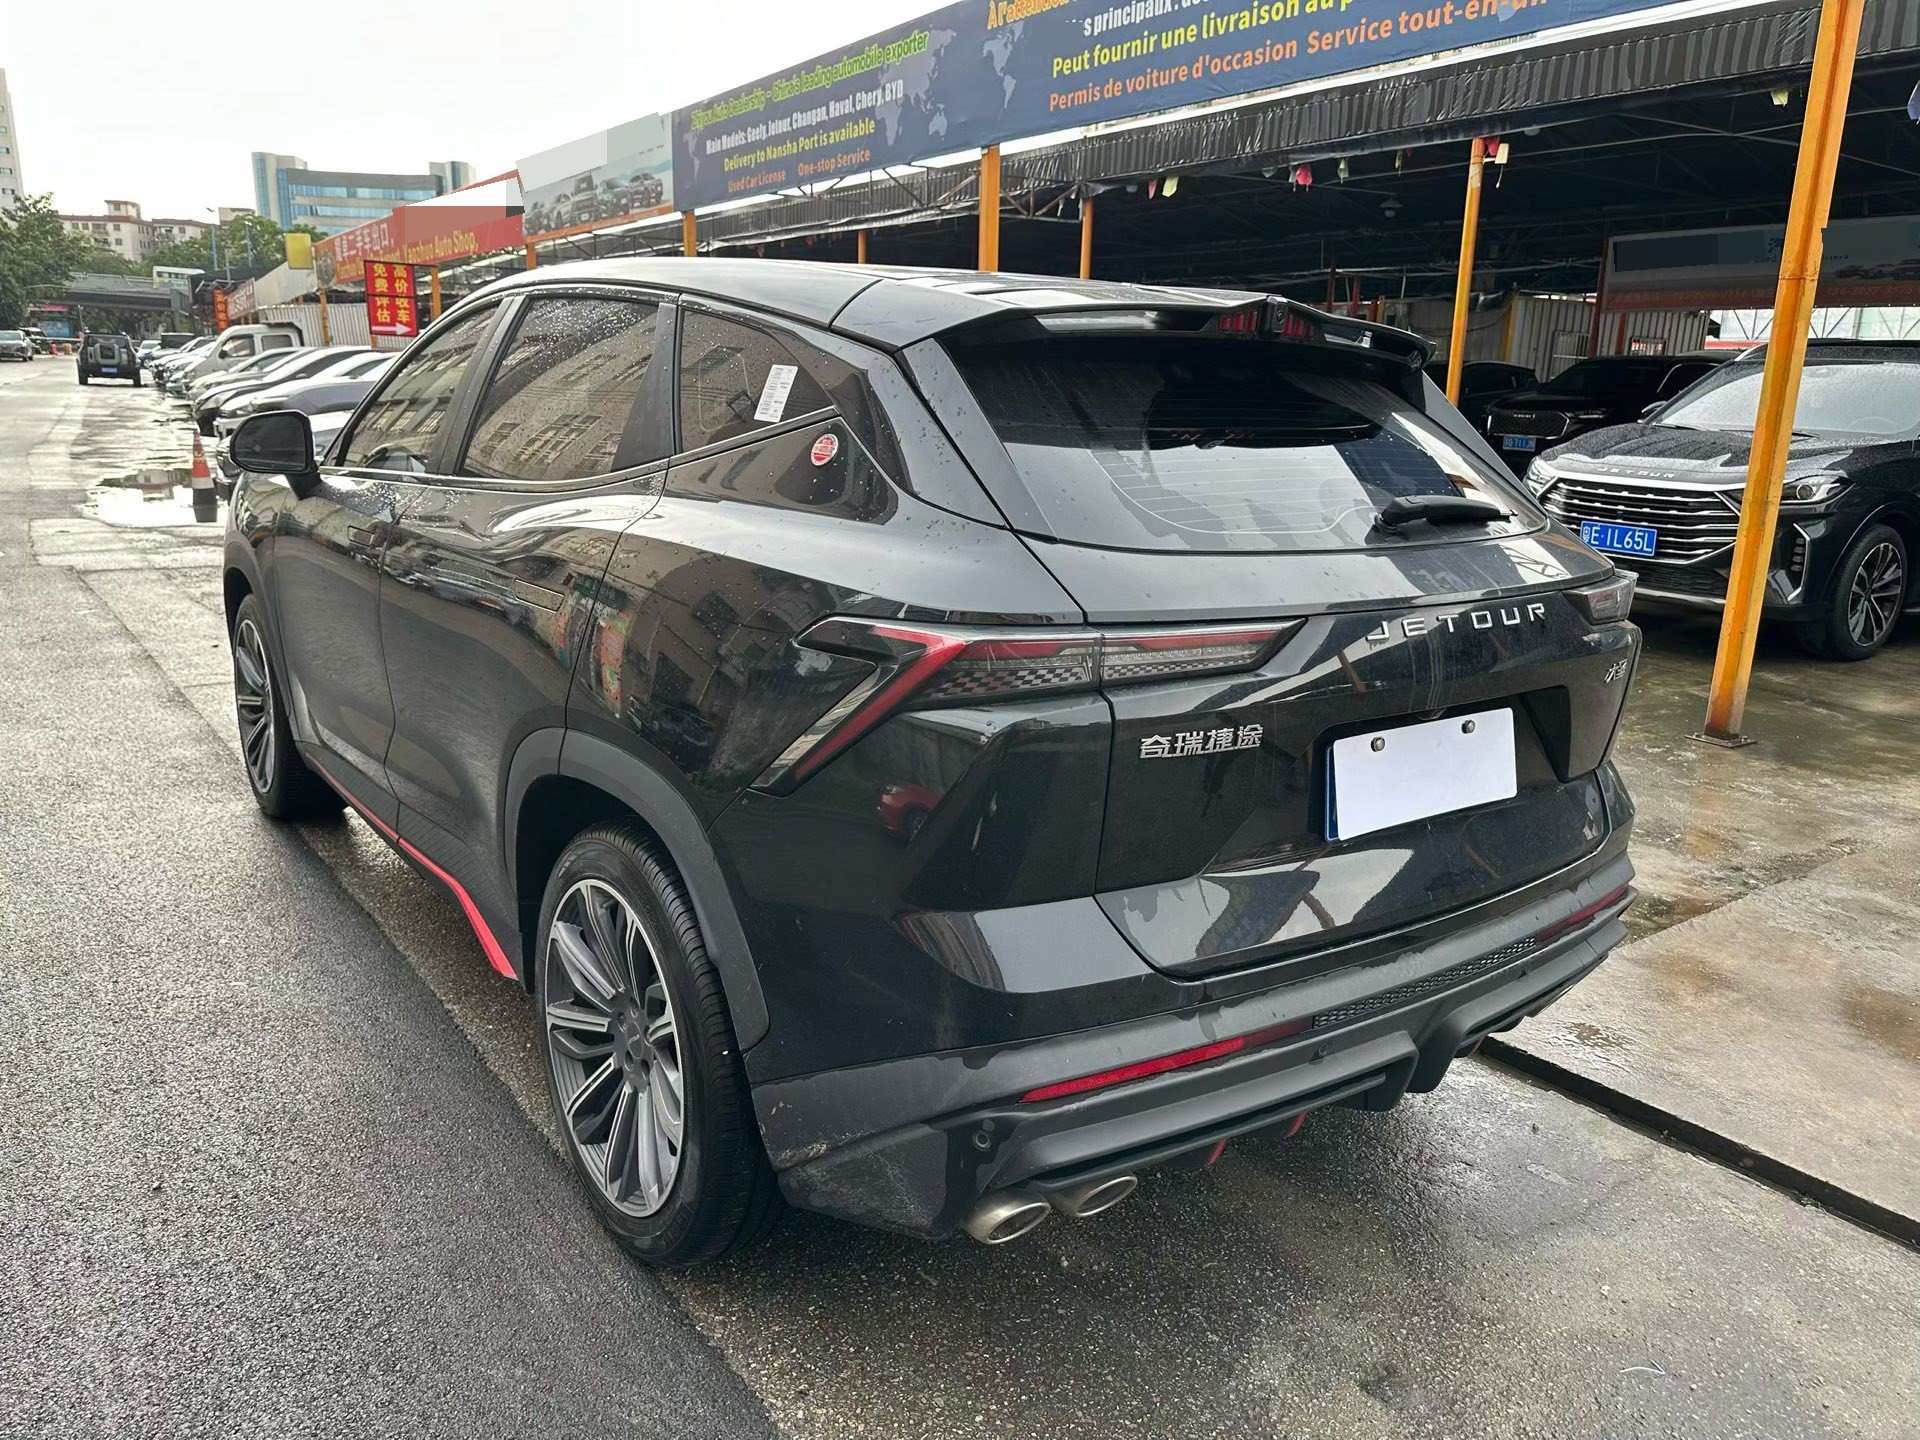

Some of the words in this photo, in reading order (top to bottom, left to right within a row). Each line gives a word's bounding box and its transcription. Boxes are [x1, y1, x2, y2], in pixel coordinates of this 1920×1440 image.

[1052, 54, 1090, 78] Peut
[1093, 30, 1159, 67] fournir
[1161, 24, 1197, 50] une
[1202, 0, 1300, 39] livraison
[772, 75, 801, 101] China's
[800, 65, 832, 91] leading
[832, 44, 883, 79] automobile
[885, 31, 929, 65] exporter
[1049, 83, 1101, 111] Permis
[1103, 78, 1122, 99] de
[1126, 63, 1188, 95] voiture
[1192, 38, 1297, 81] d'occasion
[1306, 17, 1392, 55] Service
[792, 104, 829, 129] Changan,
[829, 95, 855, 118] Haval,
[855, 87, 884, 110] Chery,
[885, 79, 904, 103] BYD
[723, 151, 756, 172] Delivery
[756, 148, 766, 162] to
[766, 141, 798, 160] Nansha
[798, 134, 820, 151] Port
[820, 131, 828, 146] is
[828, 117, 875, 143] available
[797, 157, 836, 177] One-stop
[836, 148, 871, 169] Service
[727, 176, 745, 193] Used
[745, 175, 759, 189] Car
[759, 170, 786, 187] License
[434, 235, 452, 259] Auto
[452, 229, 479, 255] Shop,
[1597, 467, 1675, 479] JETOUR
[1365, 602, 1546, 641] JETOUR
[1139, 723, 1264, 759] 奇瑞捷途
